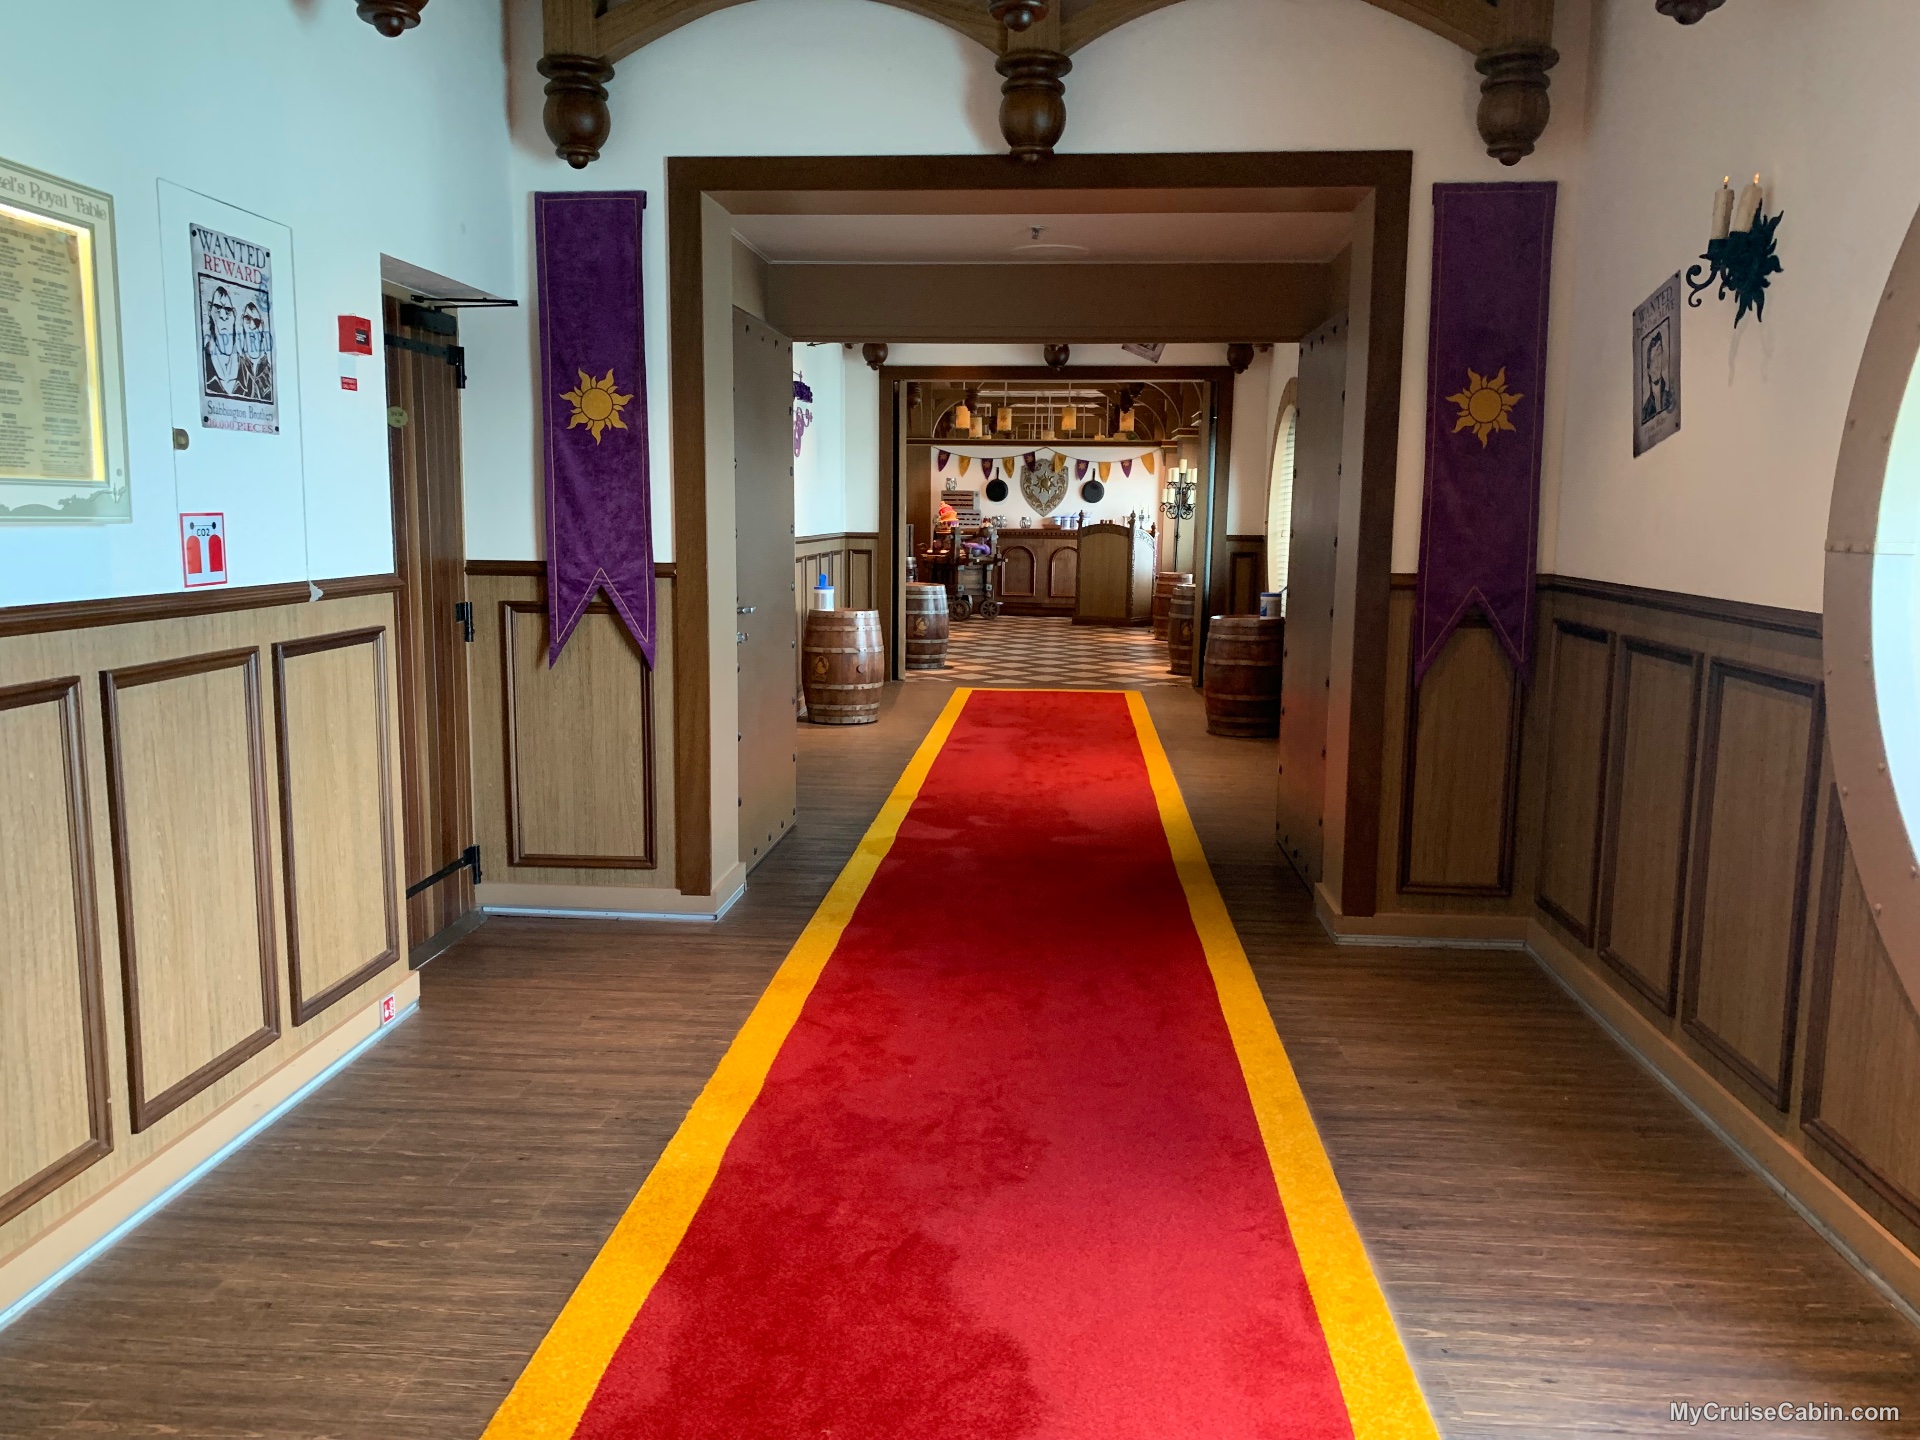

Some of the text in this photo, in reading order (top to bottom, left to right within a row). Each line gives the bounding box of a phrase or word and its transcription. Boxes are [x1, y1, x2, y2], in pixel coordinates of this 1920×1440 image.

[29, 181, 68, 208] Royal
[71, 195, 108, 221] Table
[197, 228, 266, 269] WANTED
[204, 253, 263, 285] REWARD
[1639, 286, 1673, 322] WANTED
[237, 421, 273, 434] PIECES
[248, 405, 274, 421] Brothers
[196, 528, 210, 537] CO2
